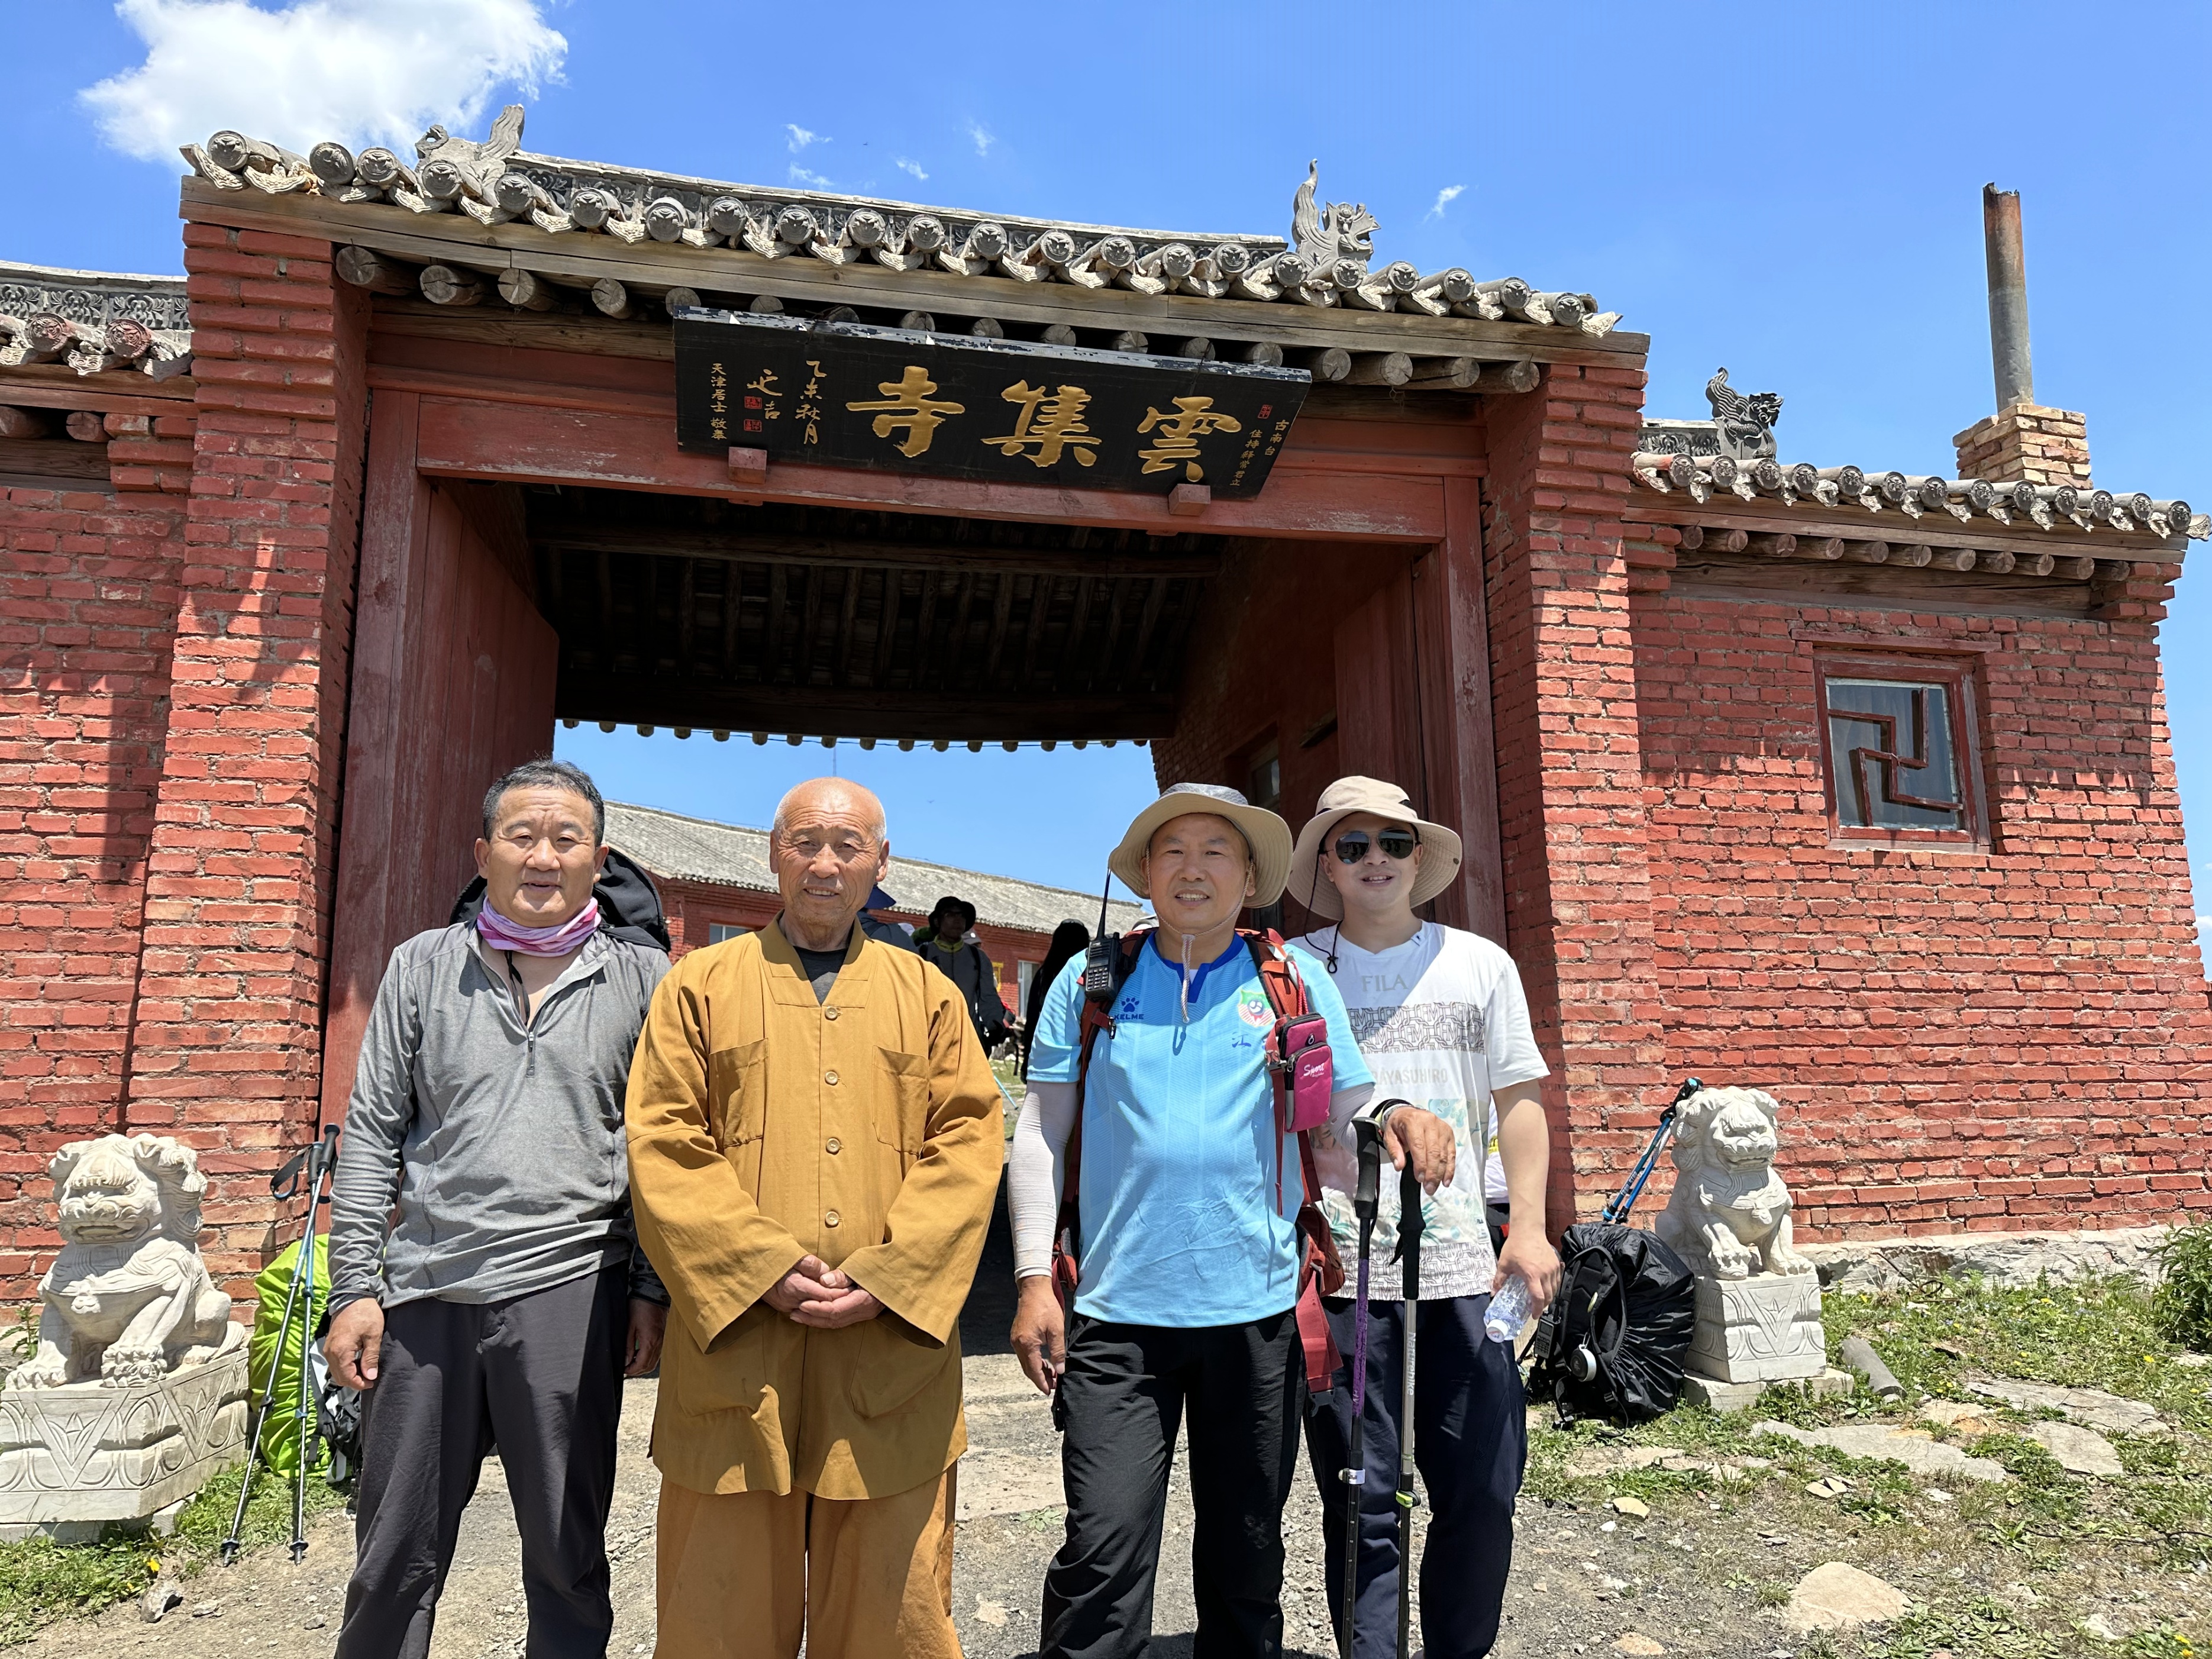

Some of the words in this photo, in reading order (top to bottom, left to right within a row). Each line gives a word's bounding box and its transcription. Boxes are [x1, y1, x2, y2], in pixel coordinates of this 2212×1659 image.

[1264, 419, 1290, 456] 古南台
[1362, 974, 1409, 992] FILA
[1303, 1063, 1325, 1077] Sport
[1407, 1332, 1416, 1396] Naturehike
